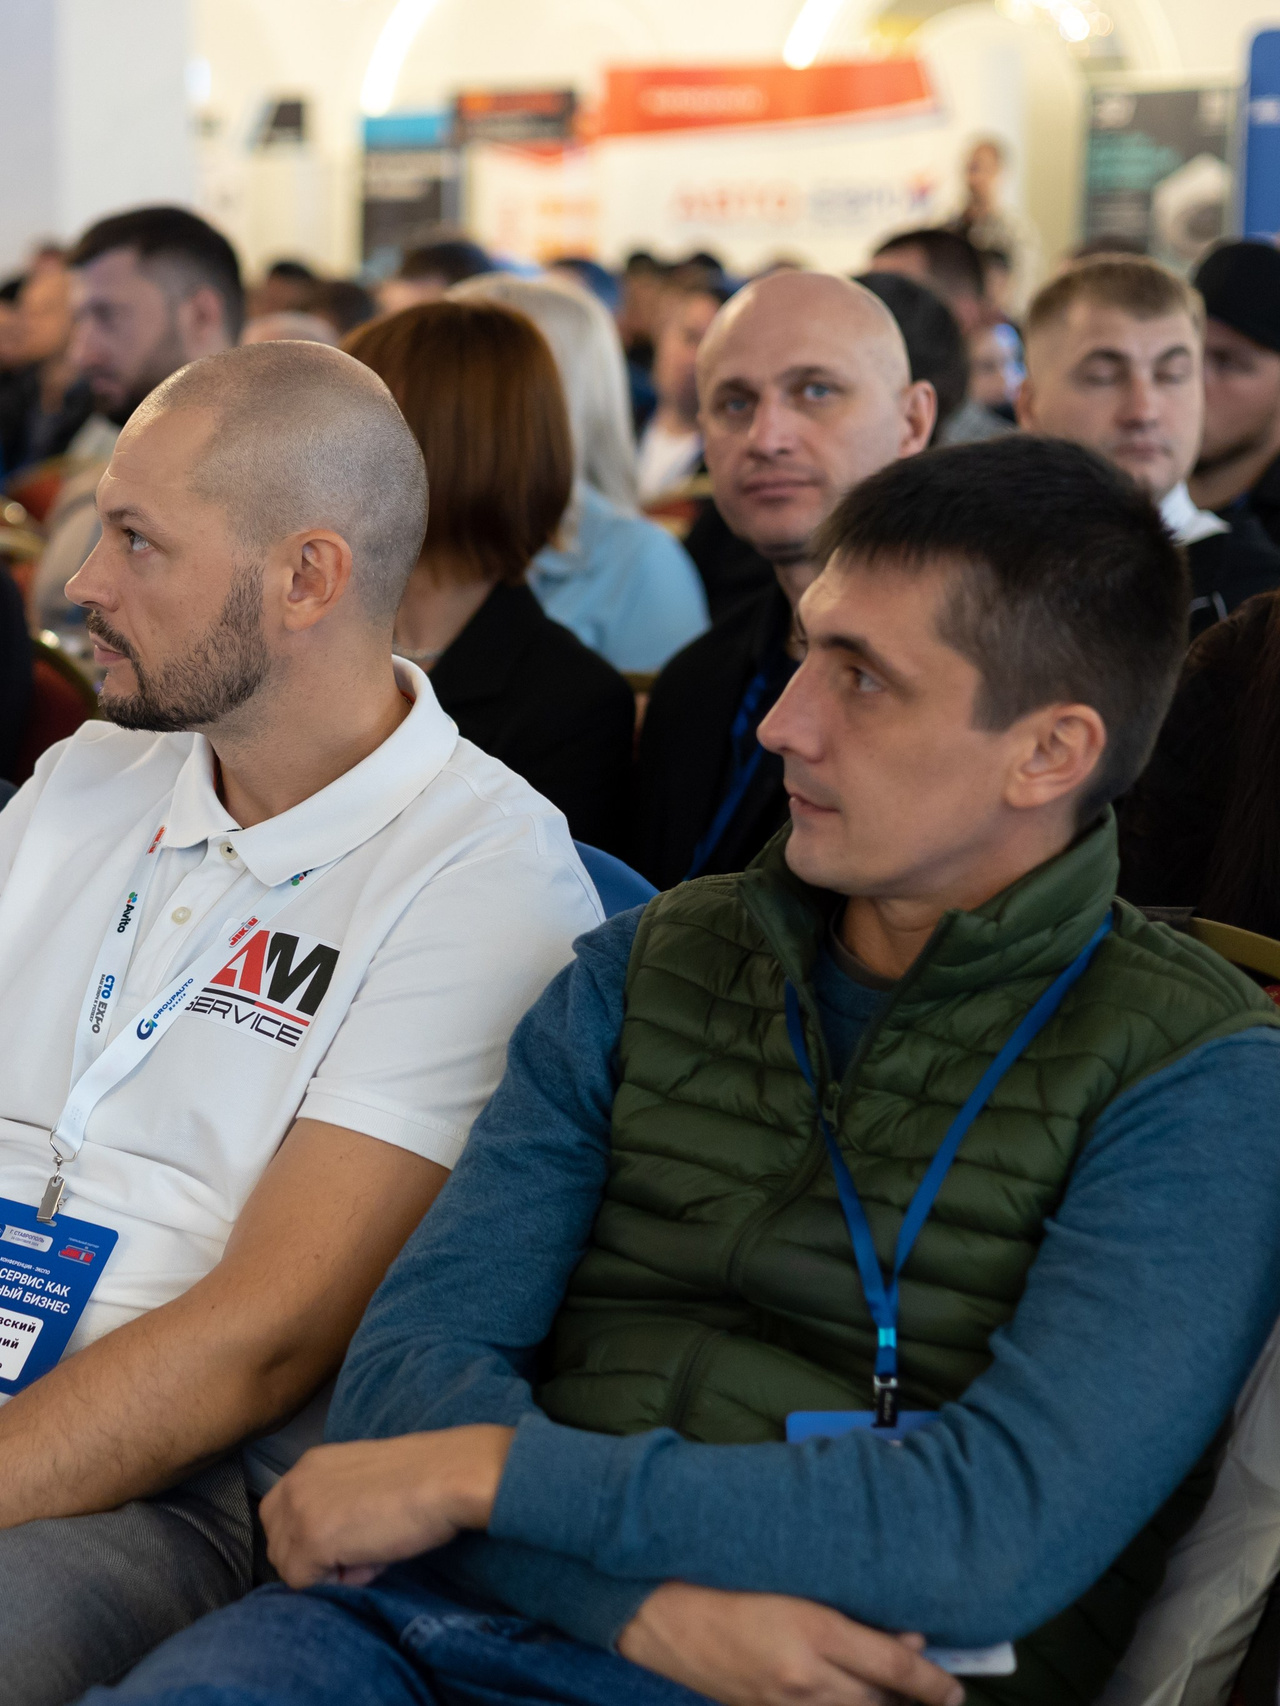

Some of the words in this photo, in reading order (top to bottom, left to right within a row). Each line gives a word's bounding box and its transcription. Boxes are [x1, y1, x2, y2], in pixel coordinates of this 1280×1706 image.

[117, 903, 135, 933] Avito
[209, 929, 341, 1016] AM
[153, 978, 194, 1019] GROUPAUTO
[92, 1001, 108, 1034] EXPO
[22, 1291, 71, 1314] БИЗНЕС
[44, 1281, 71, 1297] КАК
